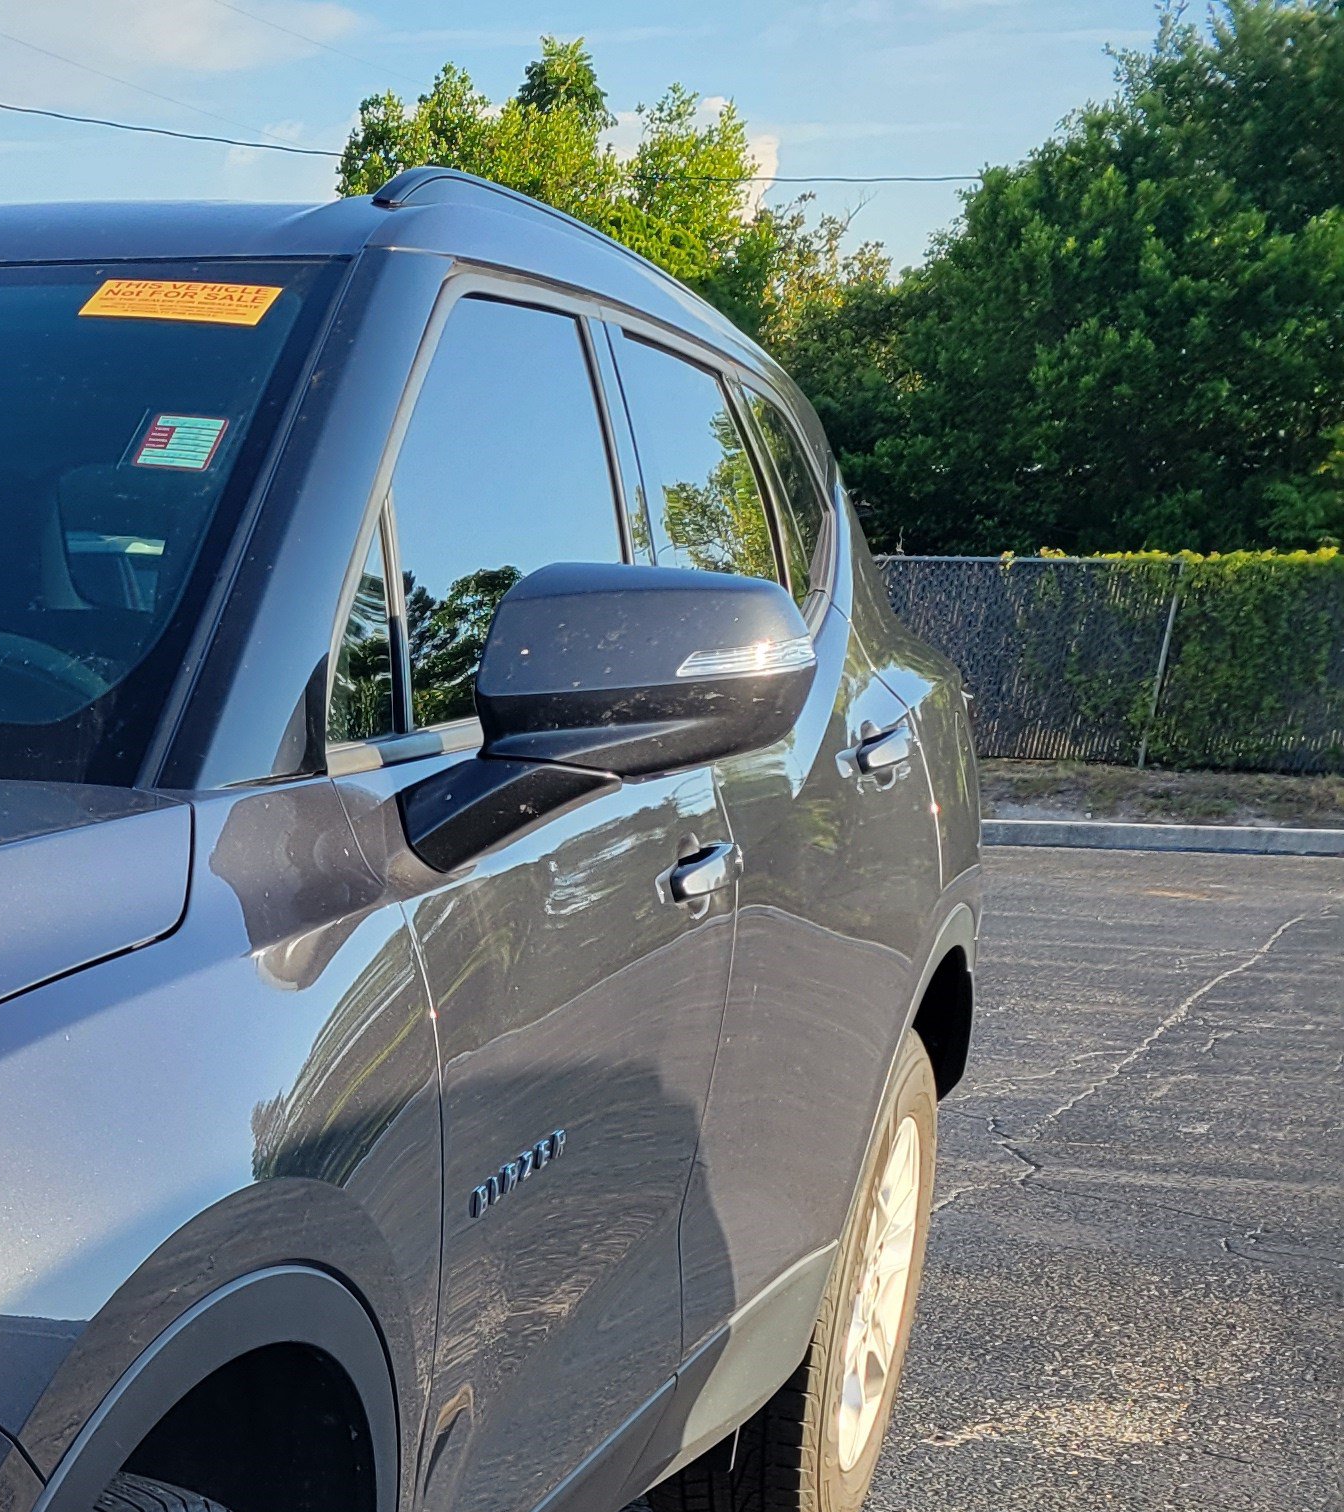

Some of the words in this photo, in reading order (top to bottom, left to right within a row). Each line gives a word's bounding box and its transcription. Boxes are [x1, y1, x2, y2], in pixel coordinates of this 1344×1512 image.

[113, 281, 163, 290] THIS
[171, 283, 270, 296] VEHICLE
[149, 290, 197, 300] FOR
[203, 292, 268, 304] SALE
[469, 1129, 567, 1218] BLAZER
